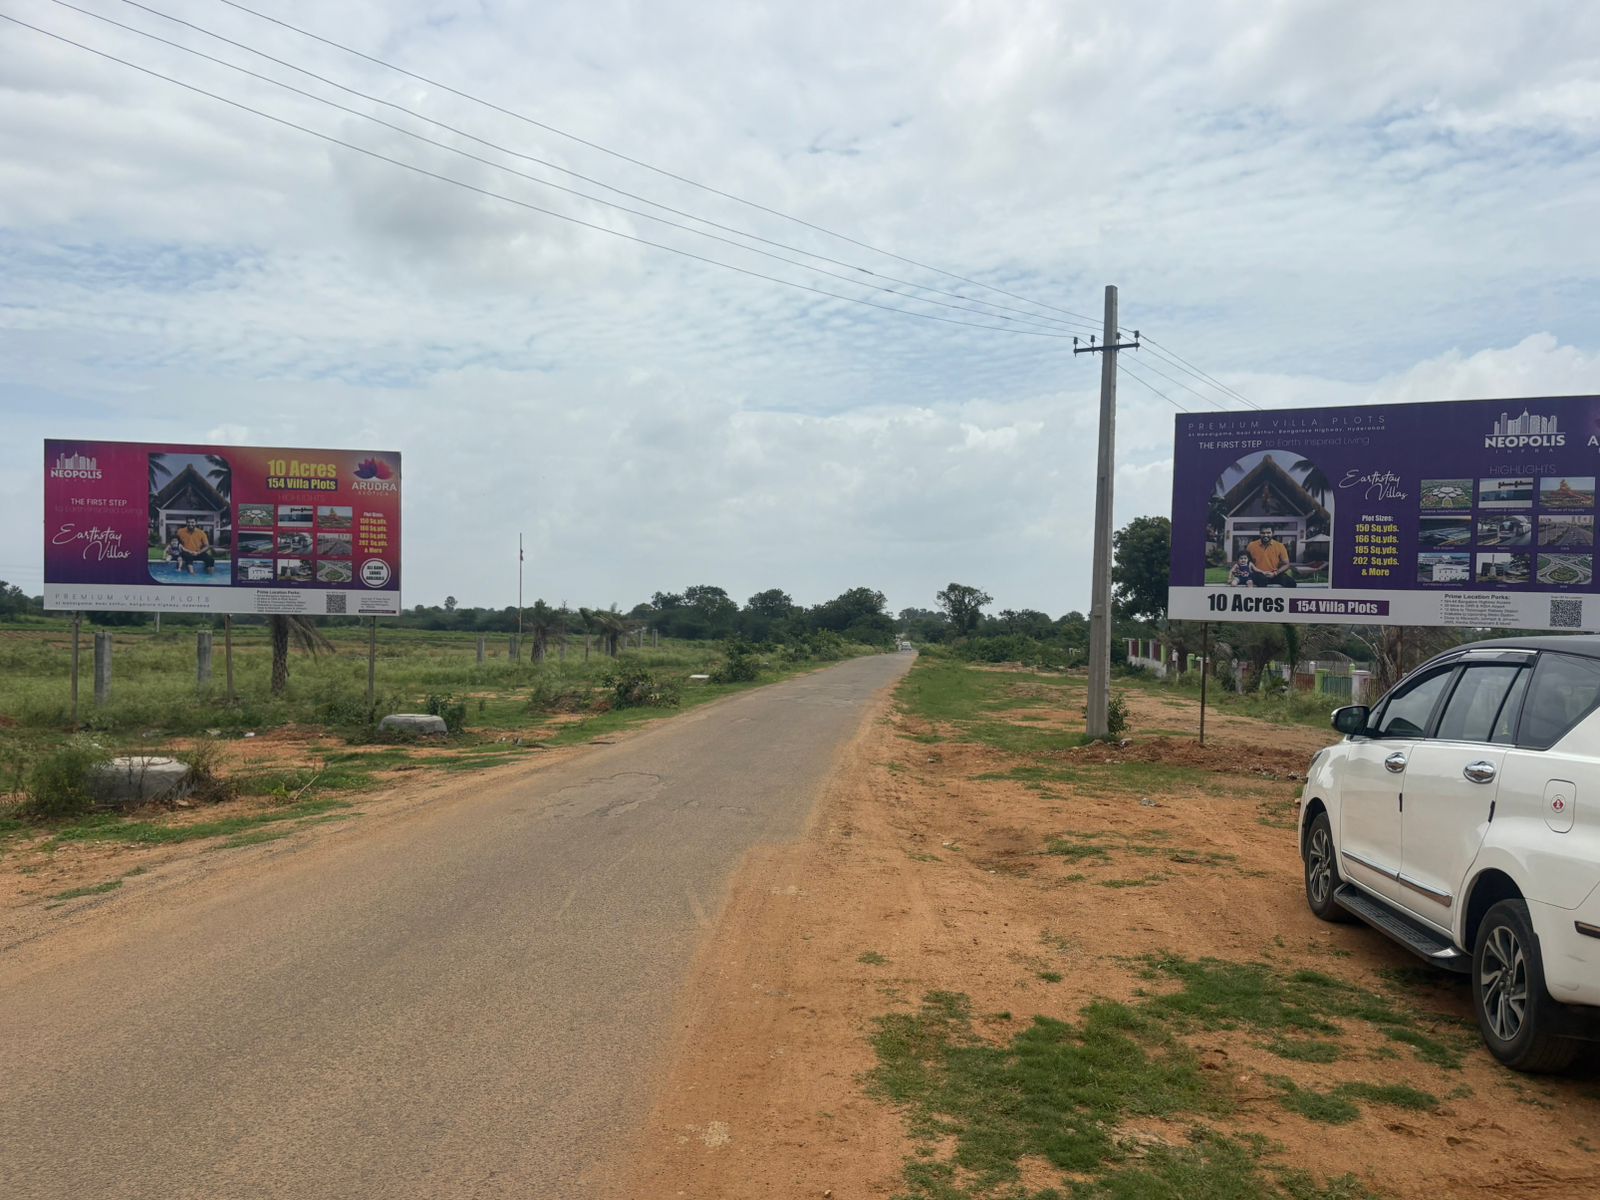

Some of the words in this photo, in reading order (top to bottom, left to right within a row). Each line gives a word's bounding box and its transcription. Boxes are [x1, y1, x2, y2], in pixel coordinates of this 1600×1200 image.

[1188, 421, 1259, 431] PREMIUM
[1272, 418, 1318, 427] VILLA
[1332, 415, 1385, 425] PLOTS
[1199, 441, 1215, 449] THE
[1216, 440, 1238, 449] FIRST
[1241, 439, 1262, 448] STEP
[1265, 439, 1275, 447] to
[1485, 435, 1566, 448] NEOPOLIS
[267, 459, 286, 476] 10
[289, 460, 336, 478] Acres
[1489, 464, 1558, 475] HIGHLIGHTS
[51, 470, 103, 479] NEOPOLIS
[1339, 469, 1401, 488] Earthstay
[268, 478, 284, 488] 154
[286, 478, 309, 489] Villa
[311, 479, 336, 490] Plots
[351, 481, 398, 491] ARUDRA
[1365, 483, 1409, 501] Villas
[71, 498, 84, 506] THE
[86, 498, 106, 507] FIRST
[109, 499, 127, 507] STEP
[1361, 514, 1375, 522] Plot
[1375, 514, 1394, 522] Sizes:
[1356, 524, 1370, 532] 150
[1371, 524, 1400, 533] Sq.yds.
[52, 523, 122, 547] Earthstay
[1355, 535, 1369, 543] 166
[1371, 535, 1399, 544] Sq.yds.
[82, 541, 132, 561] Villas
[1354, 546, 1369, 554] 185
[1370, 546, 1398, 555] Sq.yds.
[1353, 557, 1368, 565] 202
[1371, 557, 1399, 566] Sq.yds.
[1361, 568, 1367, 576] &
[1369, 568, 1390, 576] More
[1207, 594, 1228, 611] 10
[1231, 594, 1285, 612] Acres
[1296, 600, 1317, 612] 154
[1318, 600, 1346, 613] Villa
[1347, 601, 1378, 614] Plots
